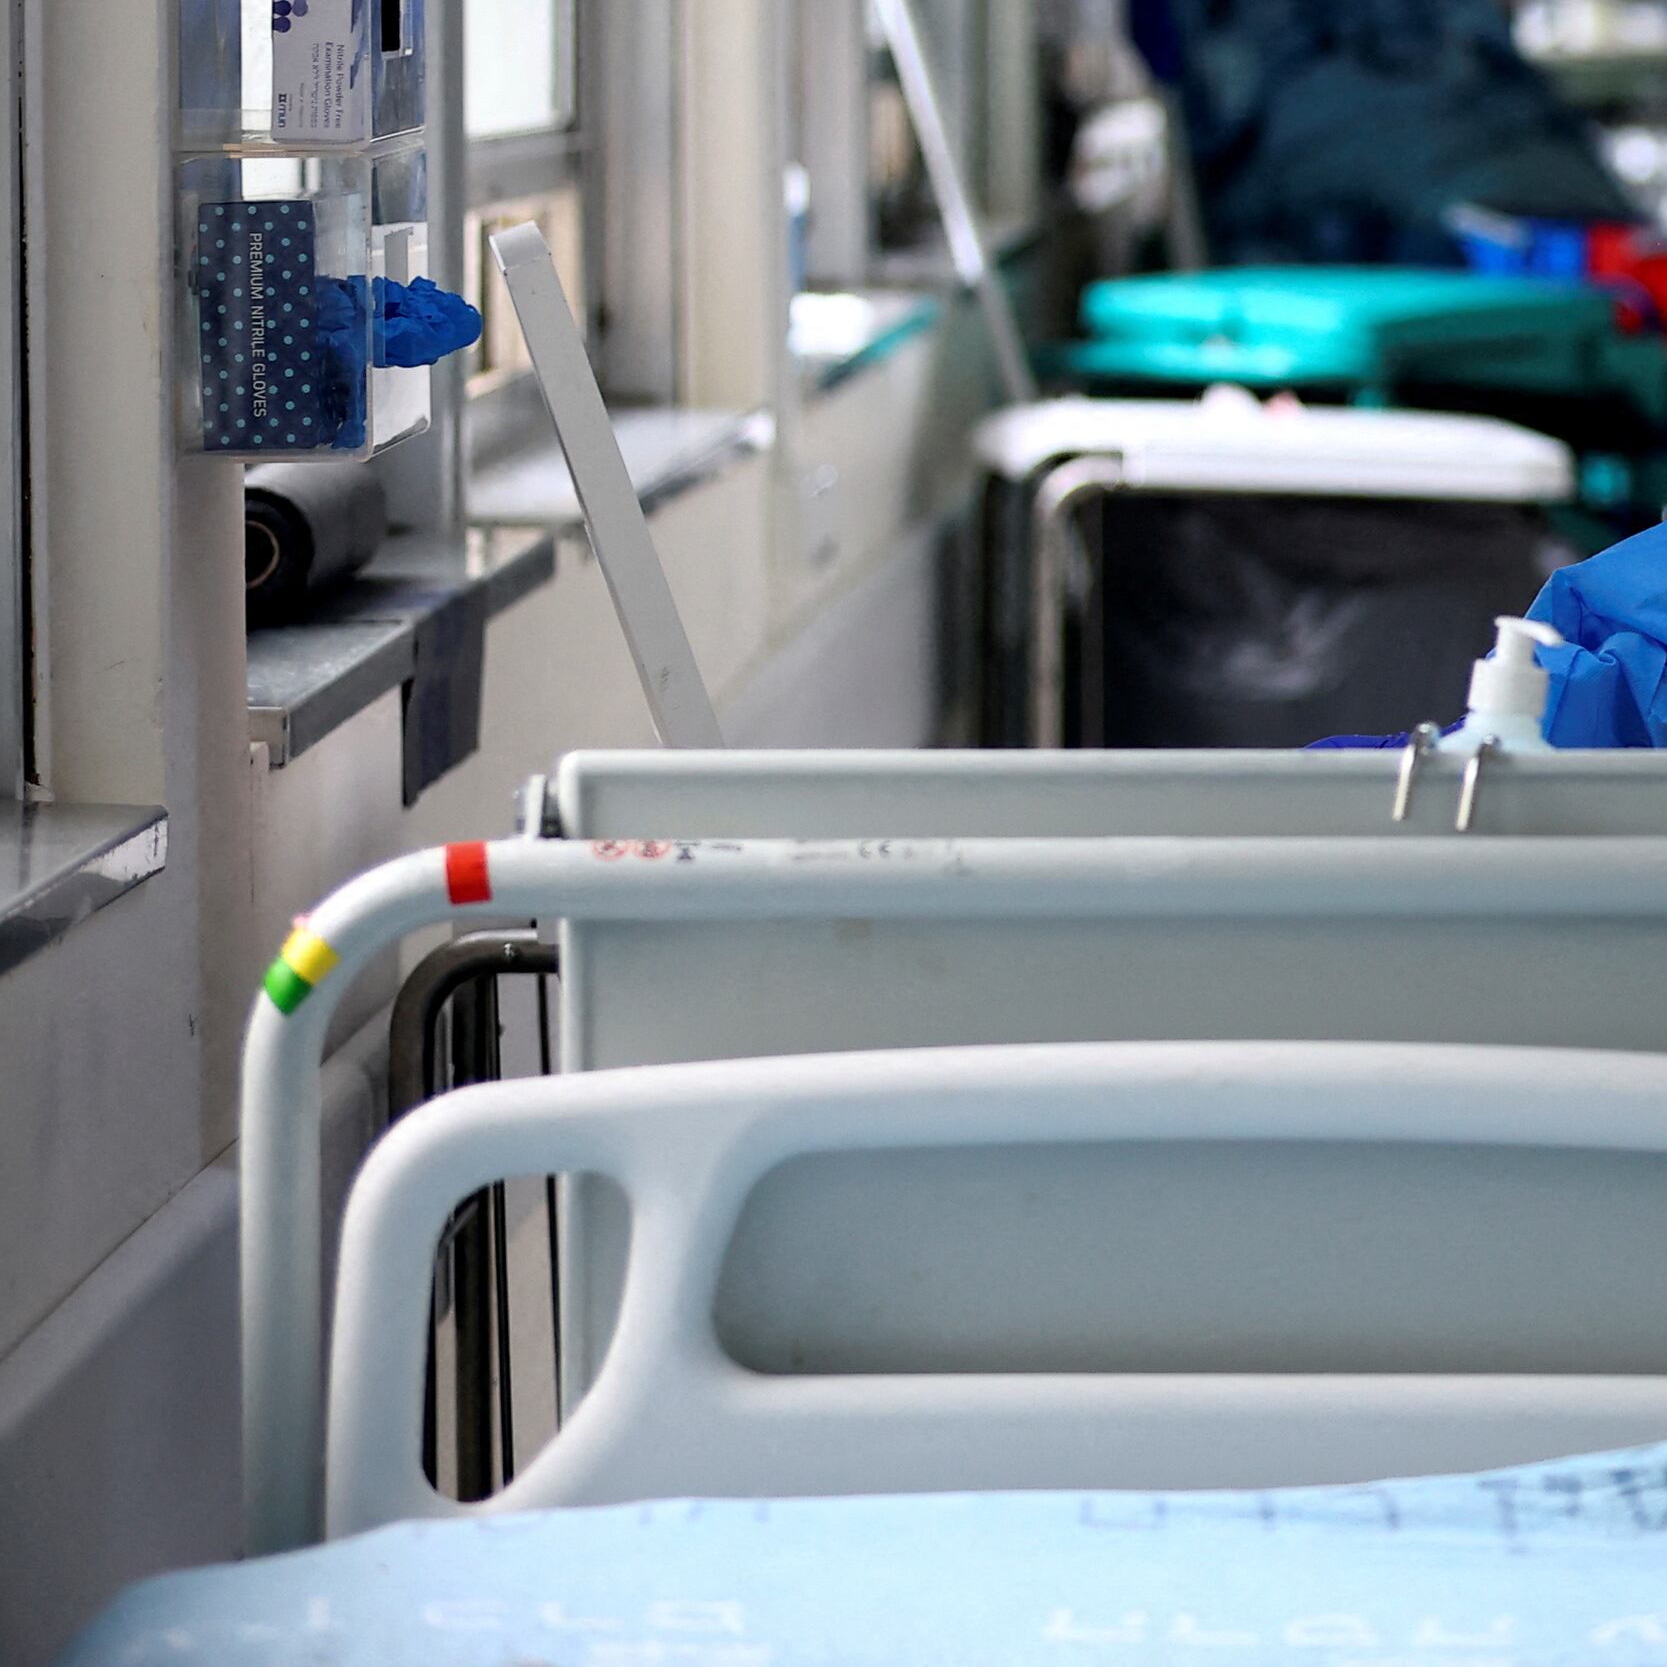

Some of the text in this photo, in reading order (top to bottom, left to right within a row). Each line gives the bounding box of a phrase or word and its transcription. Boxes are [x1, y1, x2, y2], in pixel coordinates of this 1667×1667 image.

[323, 42, 333, 128] Examination Gloves
[335, 44, 344, 128] Nitrile Powder Free
[249, 233, 267, 417] PREMIUM NITRILE GLOVES
